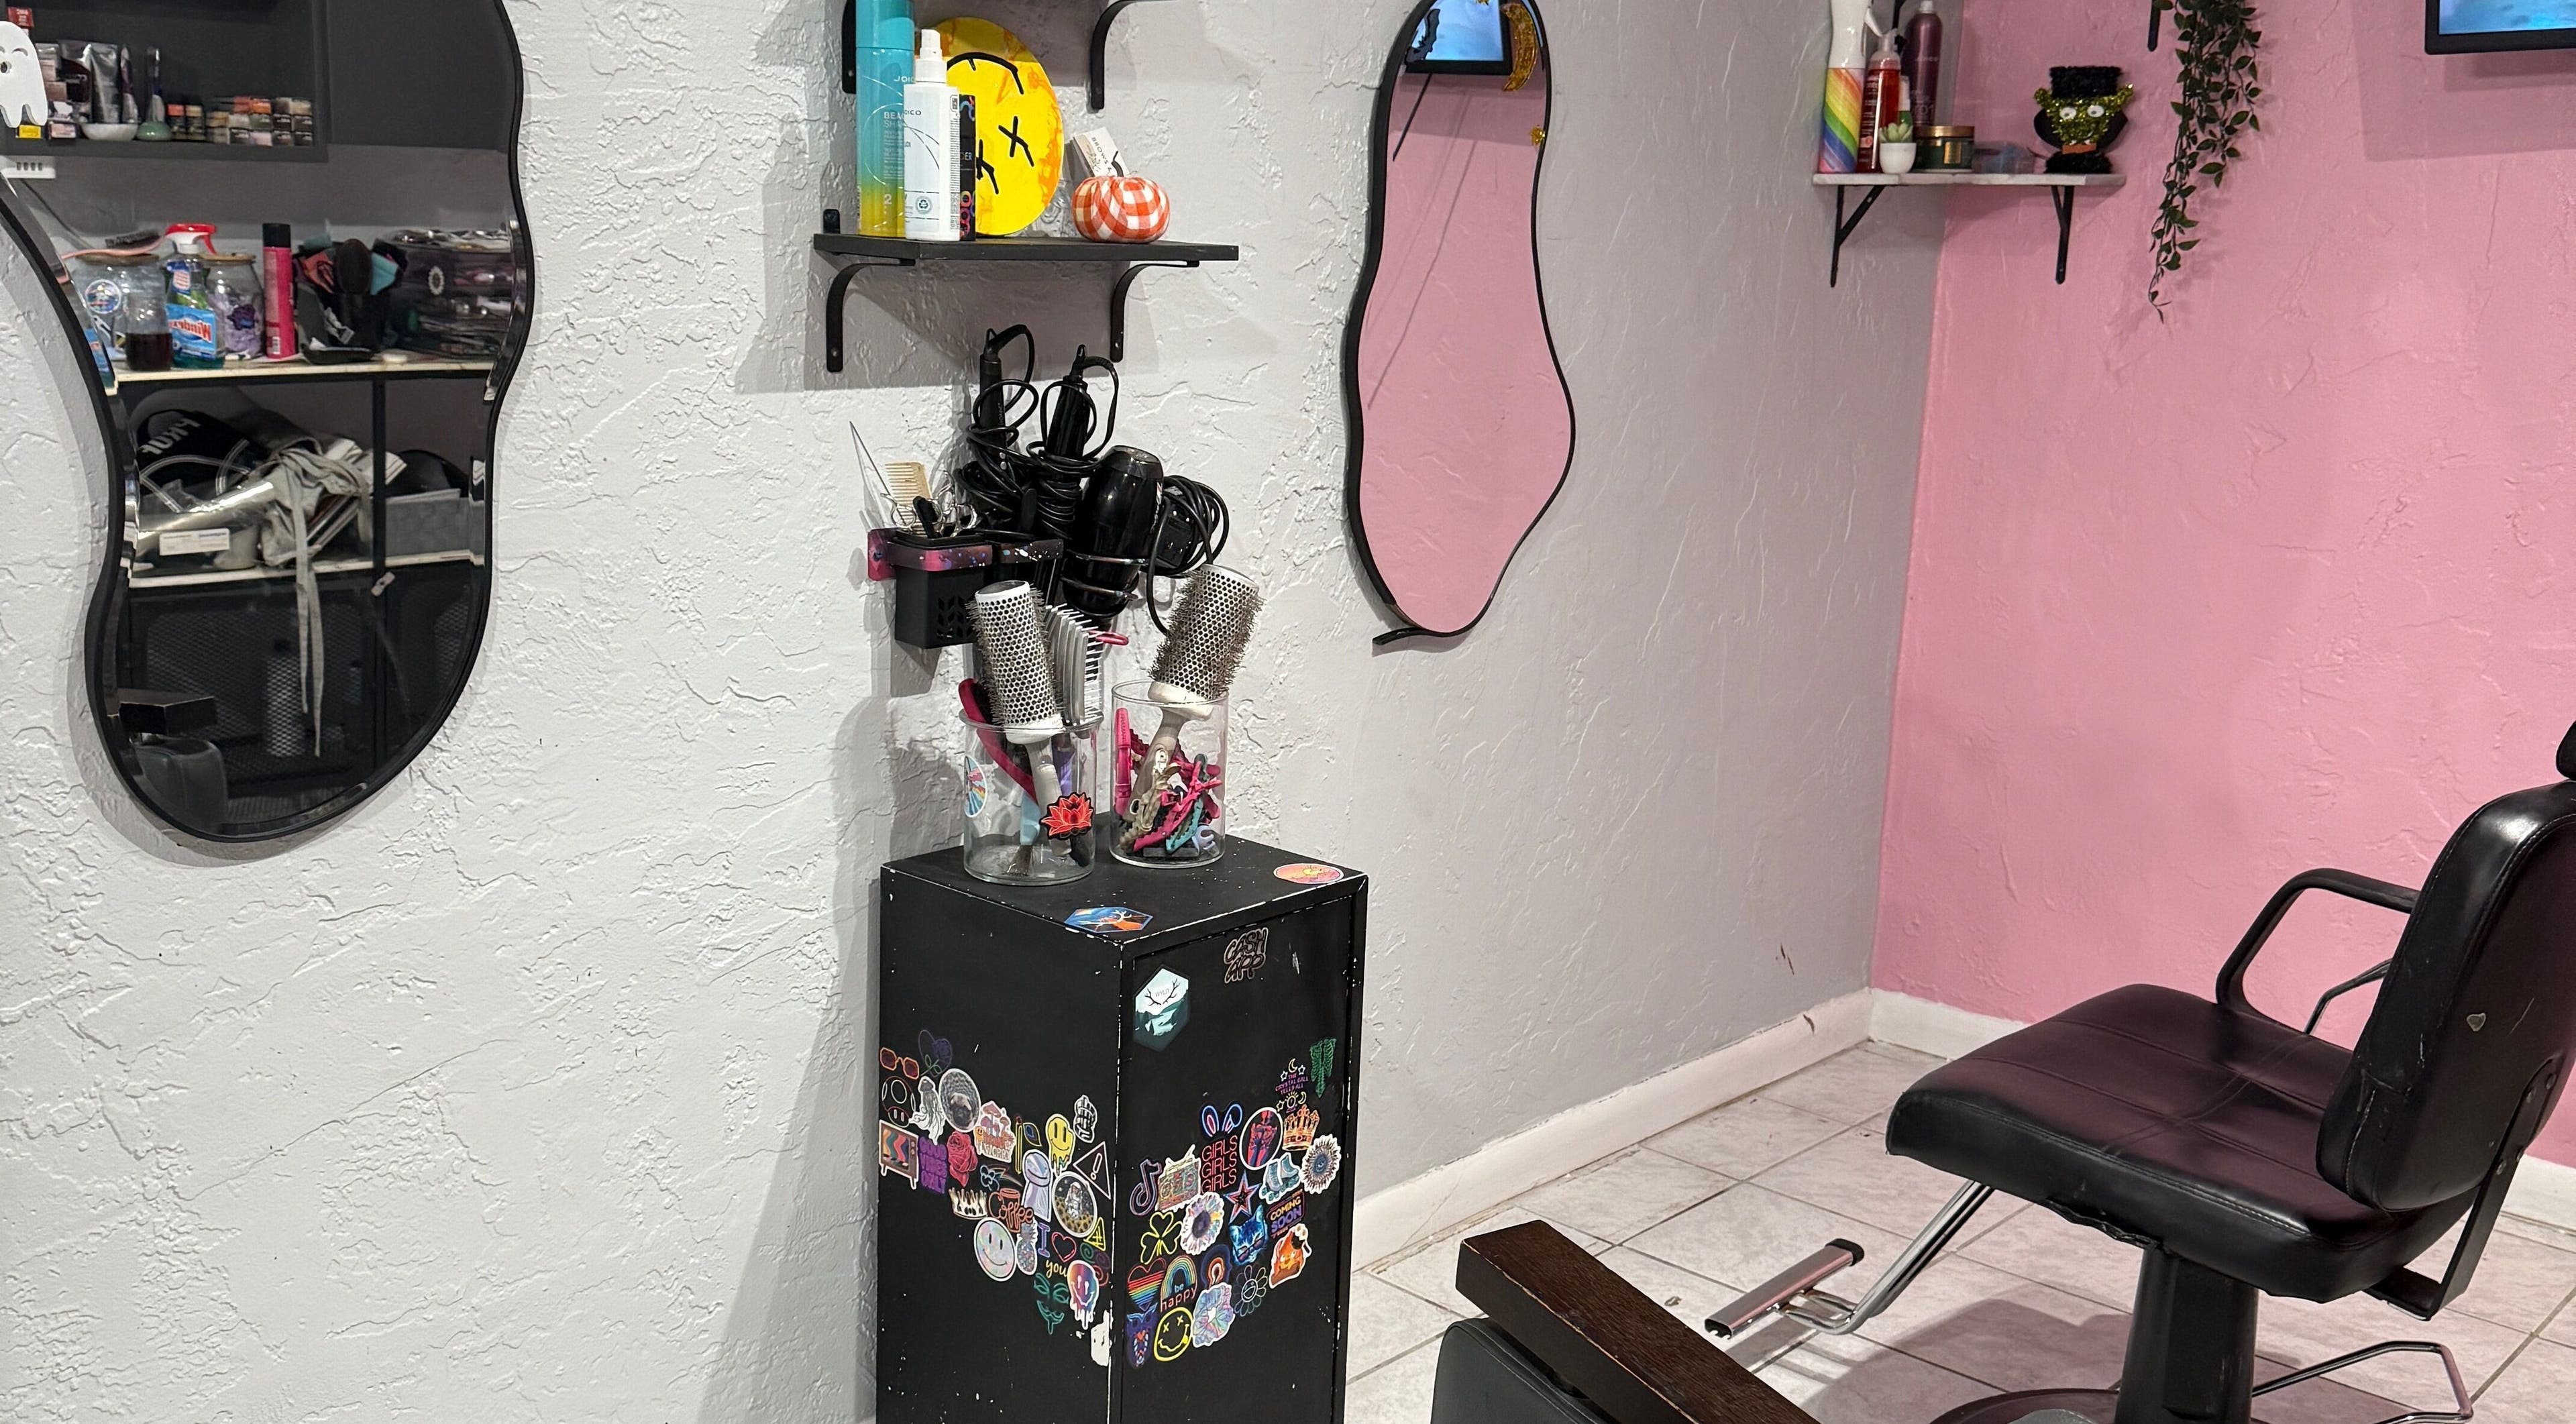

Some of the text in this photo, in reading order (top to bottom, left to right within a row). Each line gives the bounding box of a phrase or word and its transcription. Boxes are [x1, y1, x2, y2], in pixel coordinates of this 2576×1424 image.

[884, 111, 905, 119] BEAC
[1091, 137, 1108, 164] BROWS
[1224, 927, 1269, 964] CASH
[1224, 953, 1267, 984] APP
[1155, 987, 1170, 997] WYLD
[1201, 1135, 1238, 1162] GIRLS
[1201, 1152, 1237, 1179] GIRLS
[1201, 1168, 1236, 1194] GIRLS
[989, 1192, 1034, 1230] Coffee
[1270, 1196, 1301, 1221] COMING
[1271, 1205, 1302, 1234] SOON
[1038, 1222, 1051, 1258] I
[1045, 1260, 1069, 1278] you
[1161, 1287, 1196, 1313] happy
[1174, 1283, 1184, 1293] be
